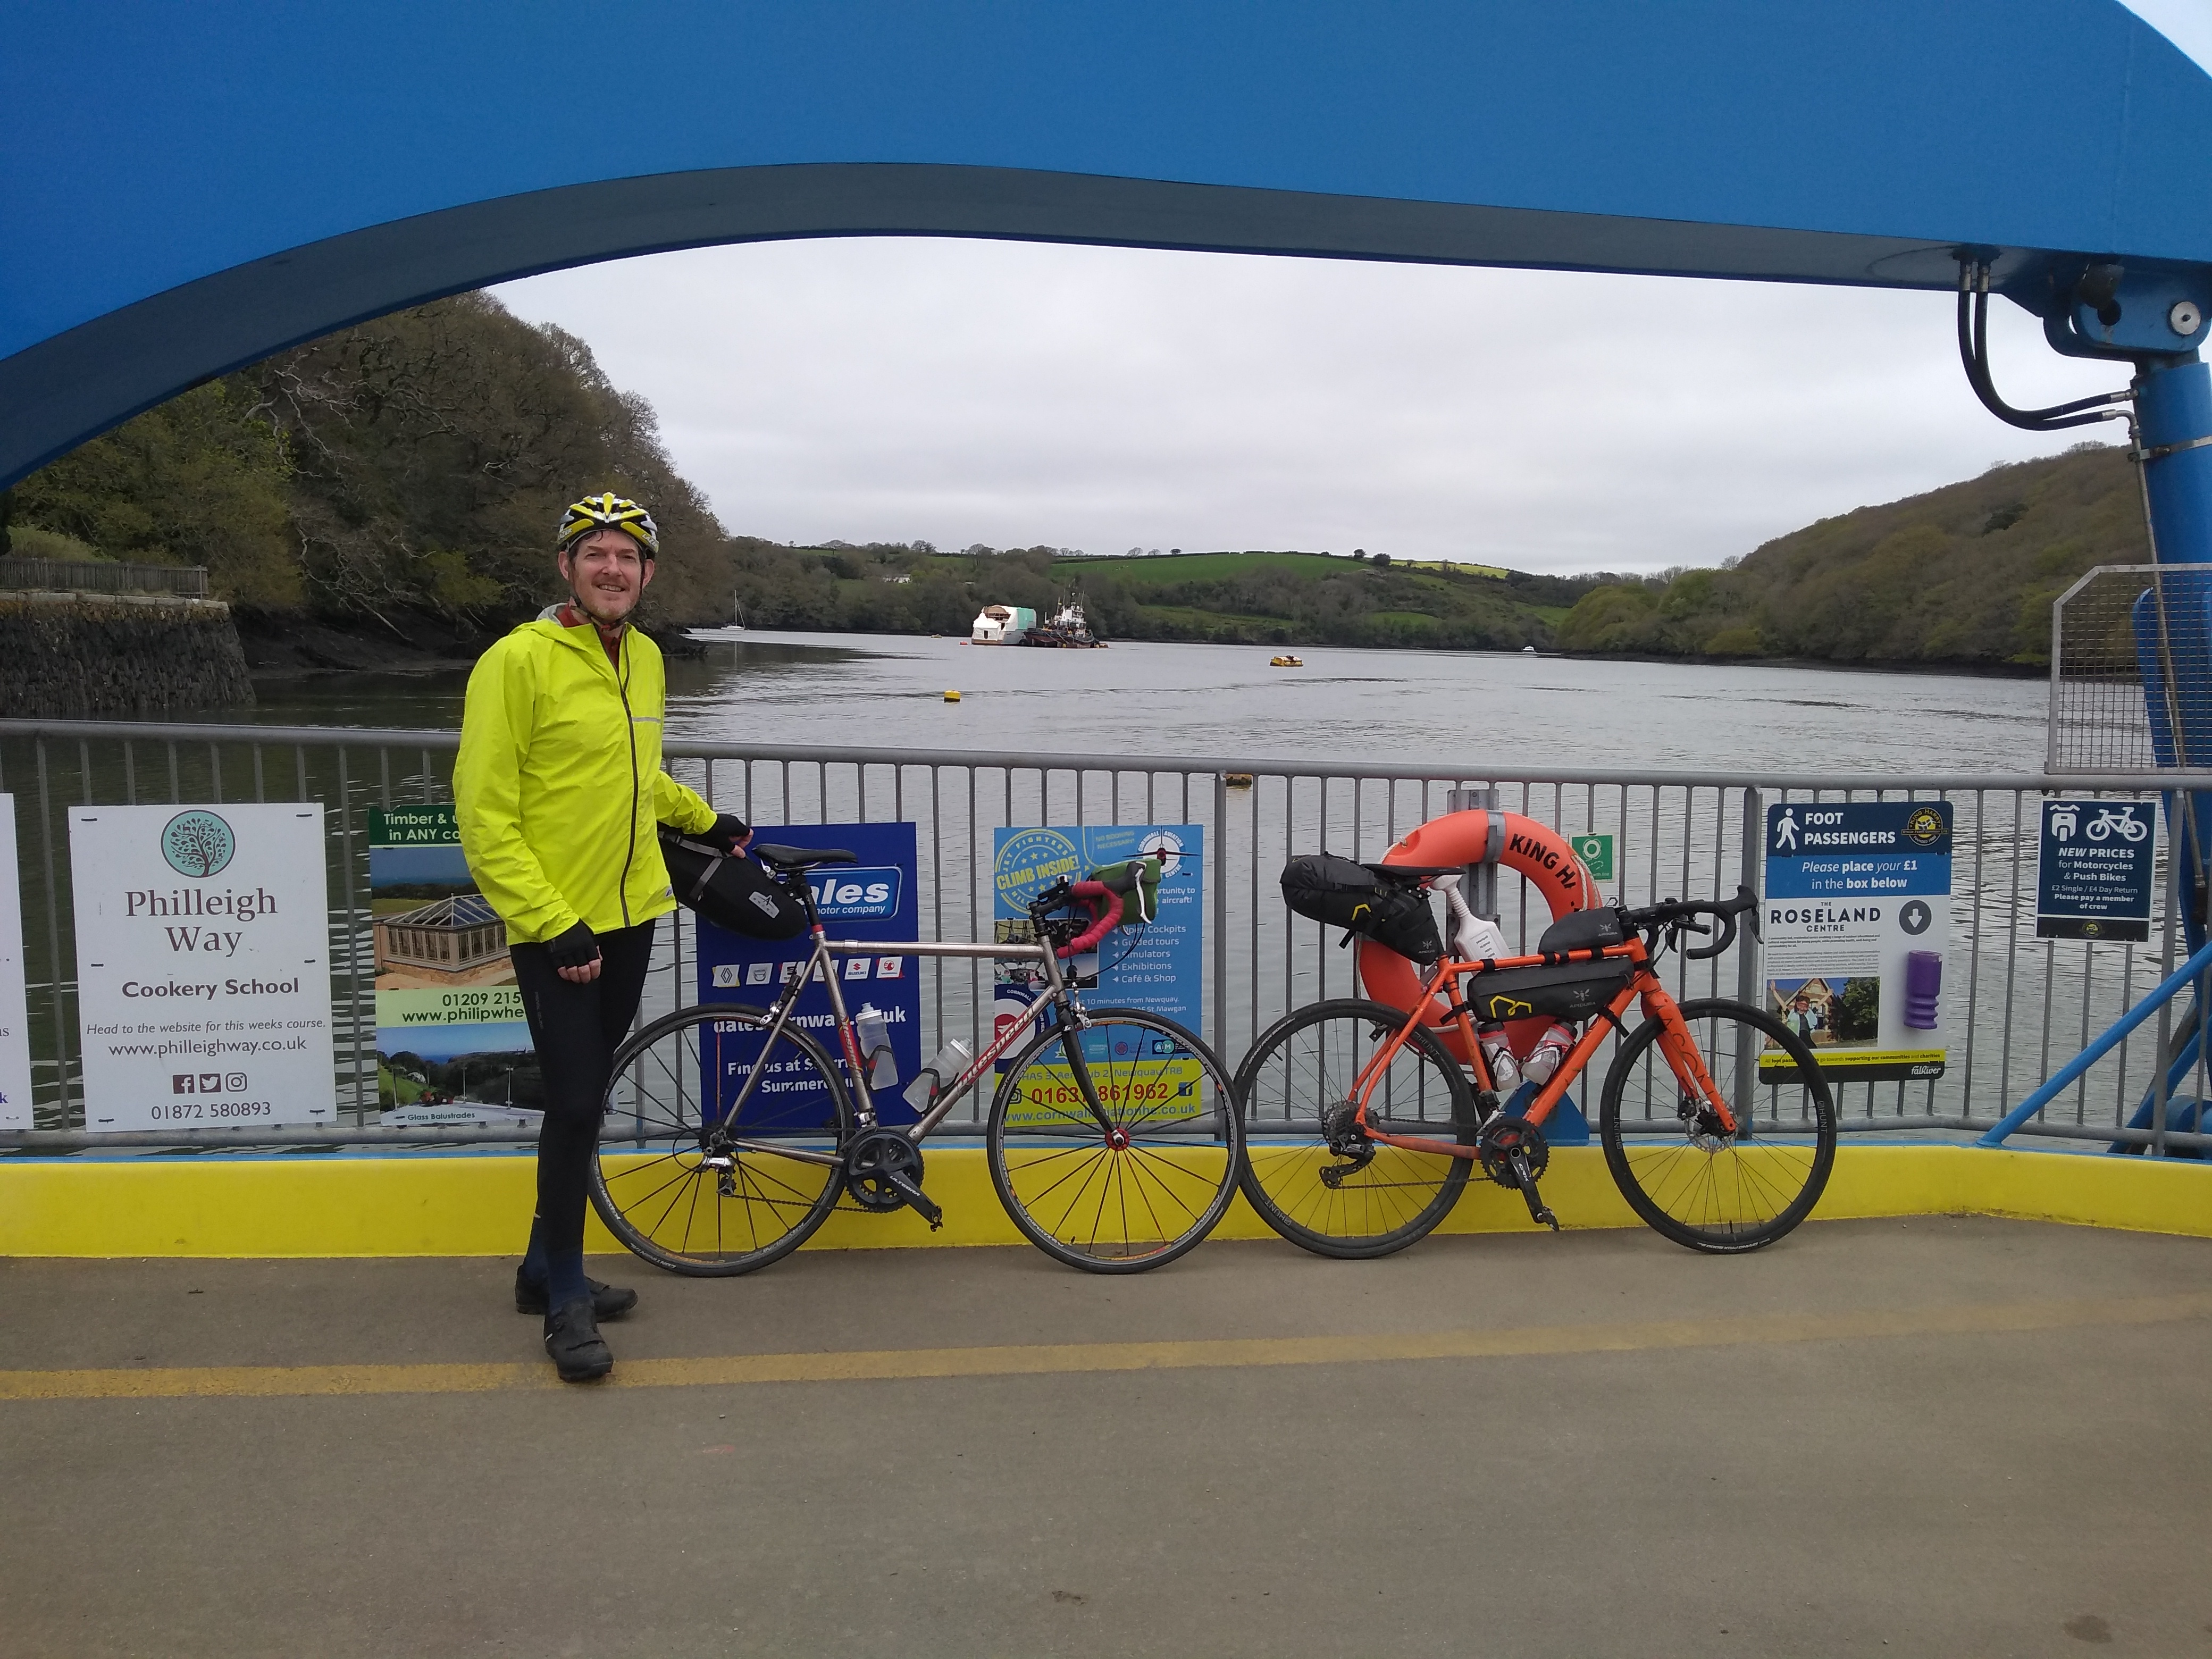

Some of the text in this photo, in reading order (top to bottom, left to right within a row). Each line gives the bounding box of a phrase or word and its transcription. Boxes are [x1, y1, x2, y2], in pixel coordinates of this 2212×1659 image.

[383, 813, 433, 825] Timber
[438, 813, 447, 824] &
[1805, 812, 1844, 825] FOOT
[1909, 809, 1941, 825] KING HARRY
[389, 828, 401, 841] in
[406, 828, 438, 841] ANY
[1138, 830, 1184, 852] CORNWALL AVIATION
[1804, 831, 1896, 845] PASSENGERS
[1509, 833, 1560, 870] KING
[2058, 848, 2135, 858] NEW PRICES
[996, 854, 1080, 890] CLIMB INSIDE!
[1165, 864, 1183, 878] CENTRE
[1802, 860, 1917, 874] Please place your £1
[2058, 860, 2133, 871] for Motorcycles
[1811, 877, 1907, 890] in the box below
[2073, 873, 2097, 881] Push
[2100, 873, 2126, 882] Bikes
[124, 887, 278, 922] Philleigh
[842, 905, 886, 915] company
[1771, 907, 1881, 924] ROSELAND
[1147, 924, 1186, 934] Cockpits
[164, 926, 243, 957] Way
[1122, 962, 1172, 971] Exhibitions
[1154, 974, 1176, 983] Shop
[122, 977, 299, 1000] Cookery School
[1007, 989, 1033, 1002] CORNWALL
[442, 992, 521, 1007] 01209 215
[402, 1006, 524, 1024] www.philipwhe
[87, 1019, 325, 1034] Head to the website for this weeks course.
[108, 1036, 307, 1059] www.philleighway.co.uk
[785, 1060, 800, 1071] at
[1022, 1071, 1043, 1080] HAS
[1097, 1083, 1168, 1102] 861962
[151, 1101, 271, 1121] 01872 580893
[1819, 1108, 1828, 1134] HUNT
